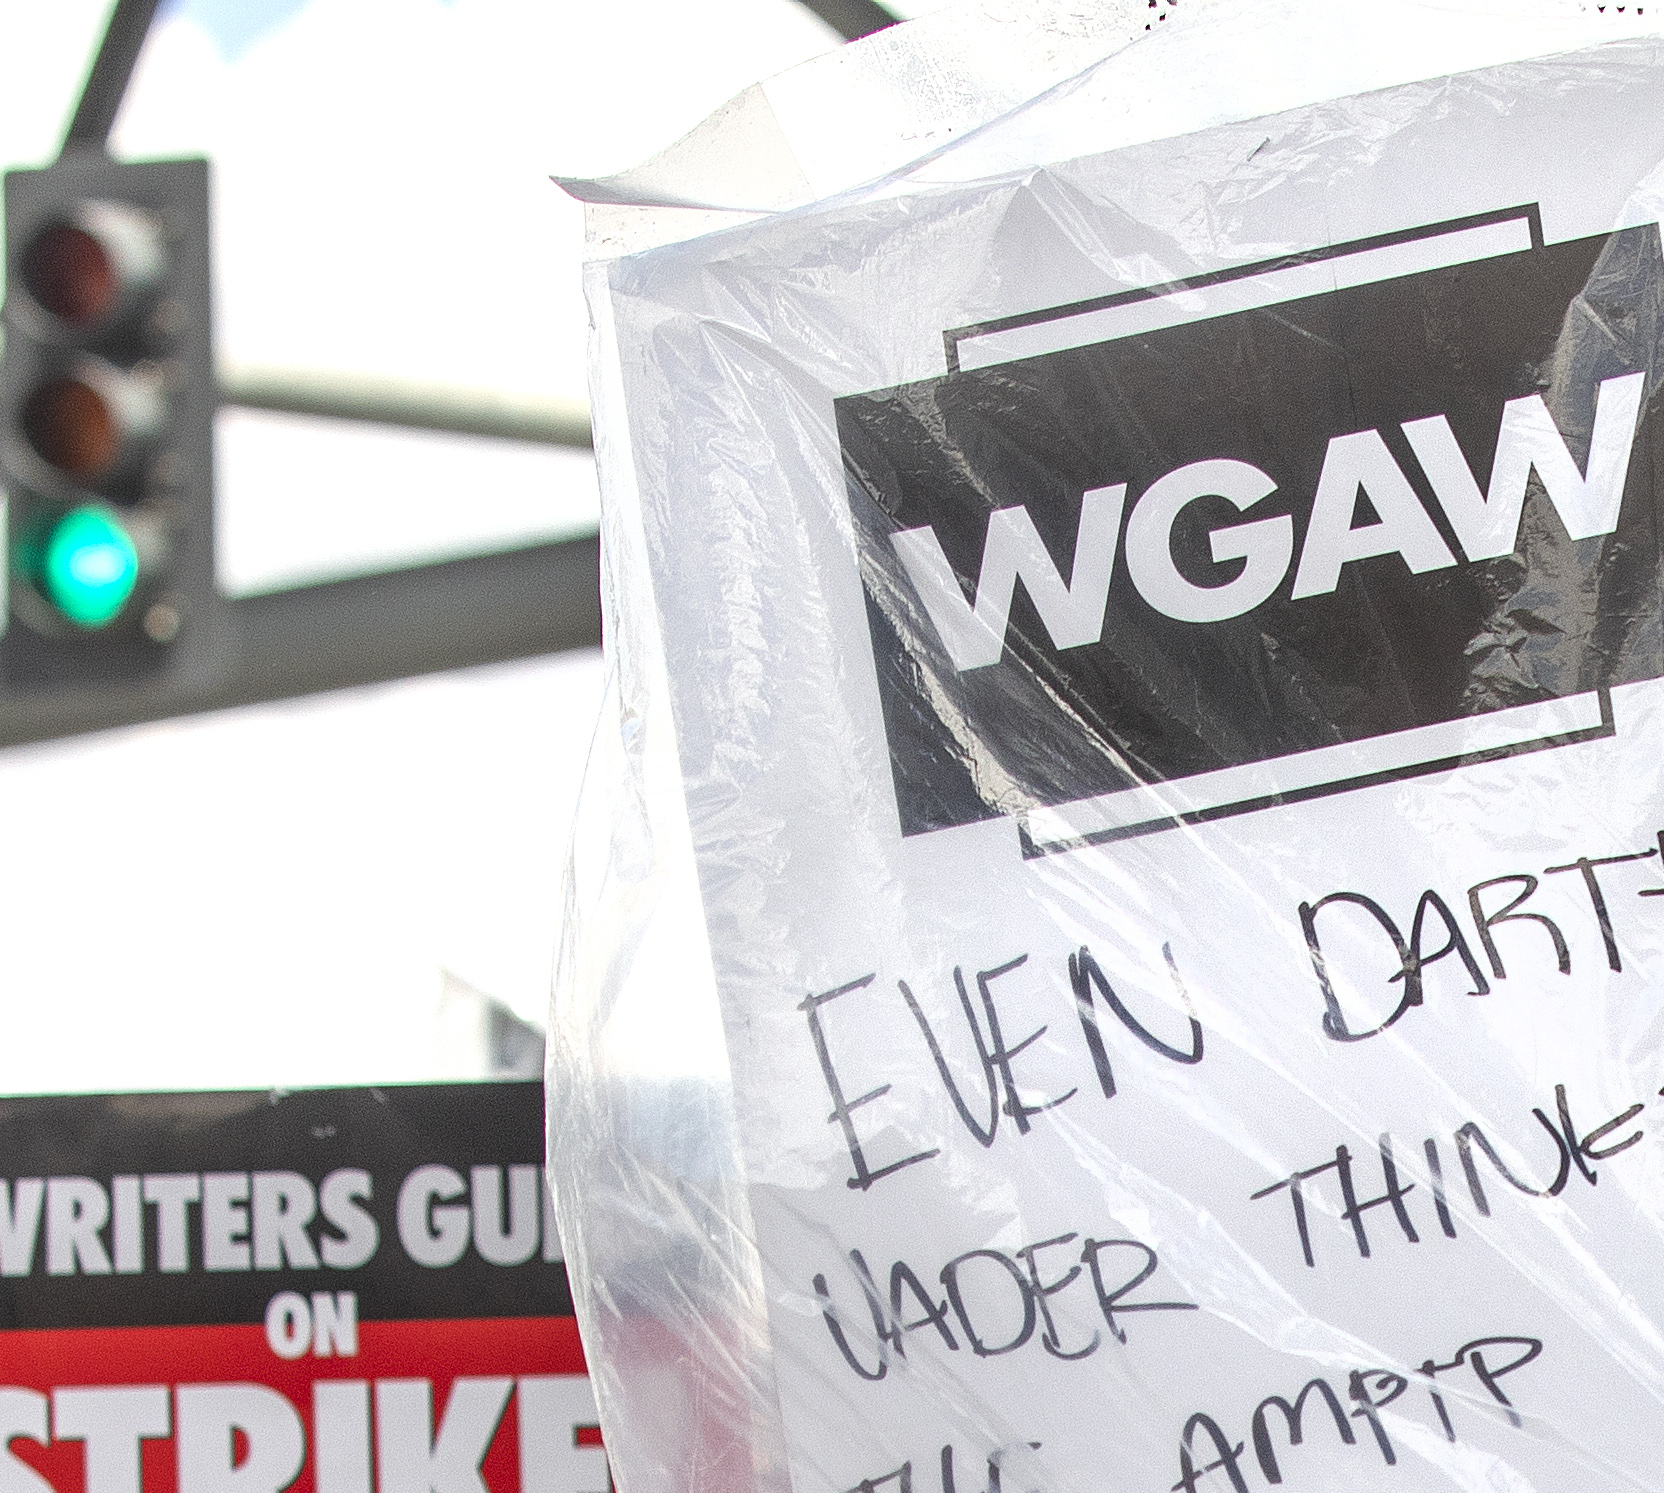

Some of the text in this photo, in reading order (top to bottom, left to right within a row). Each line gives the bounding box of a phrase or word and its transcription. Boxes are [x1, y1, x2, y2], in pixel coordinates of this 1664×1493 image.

[892, 372, 1646, 672] WGAW
[797, 943, 1205, 1190] EVEN
[396, 1163, 565, 1268] GUI
[267, 1290, 358, 1359] ON
